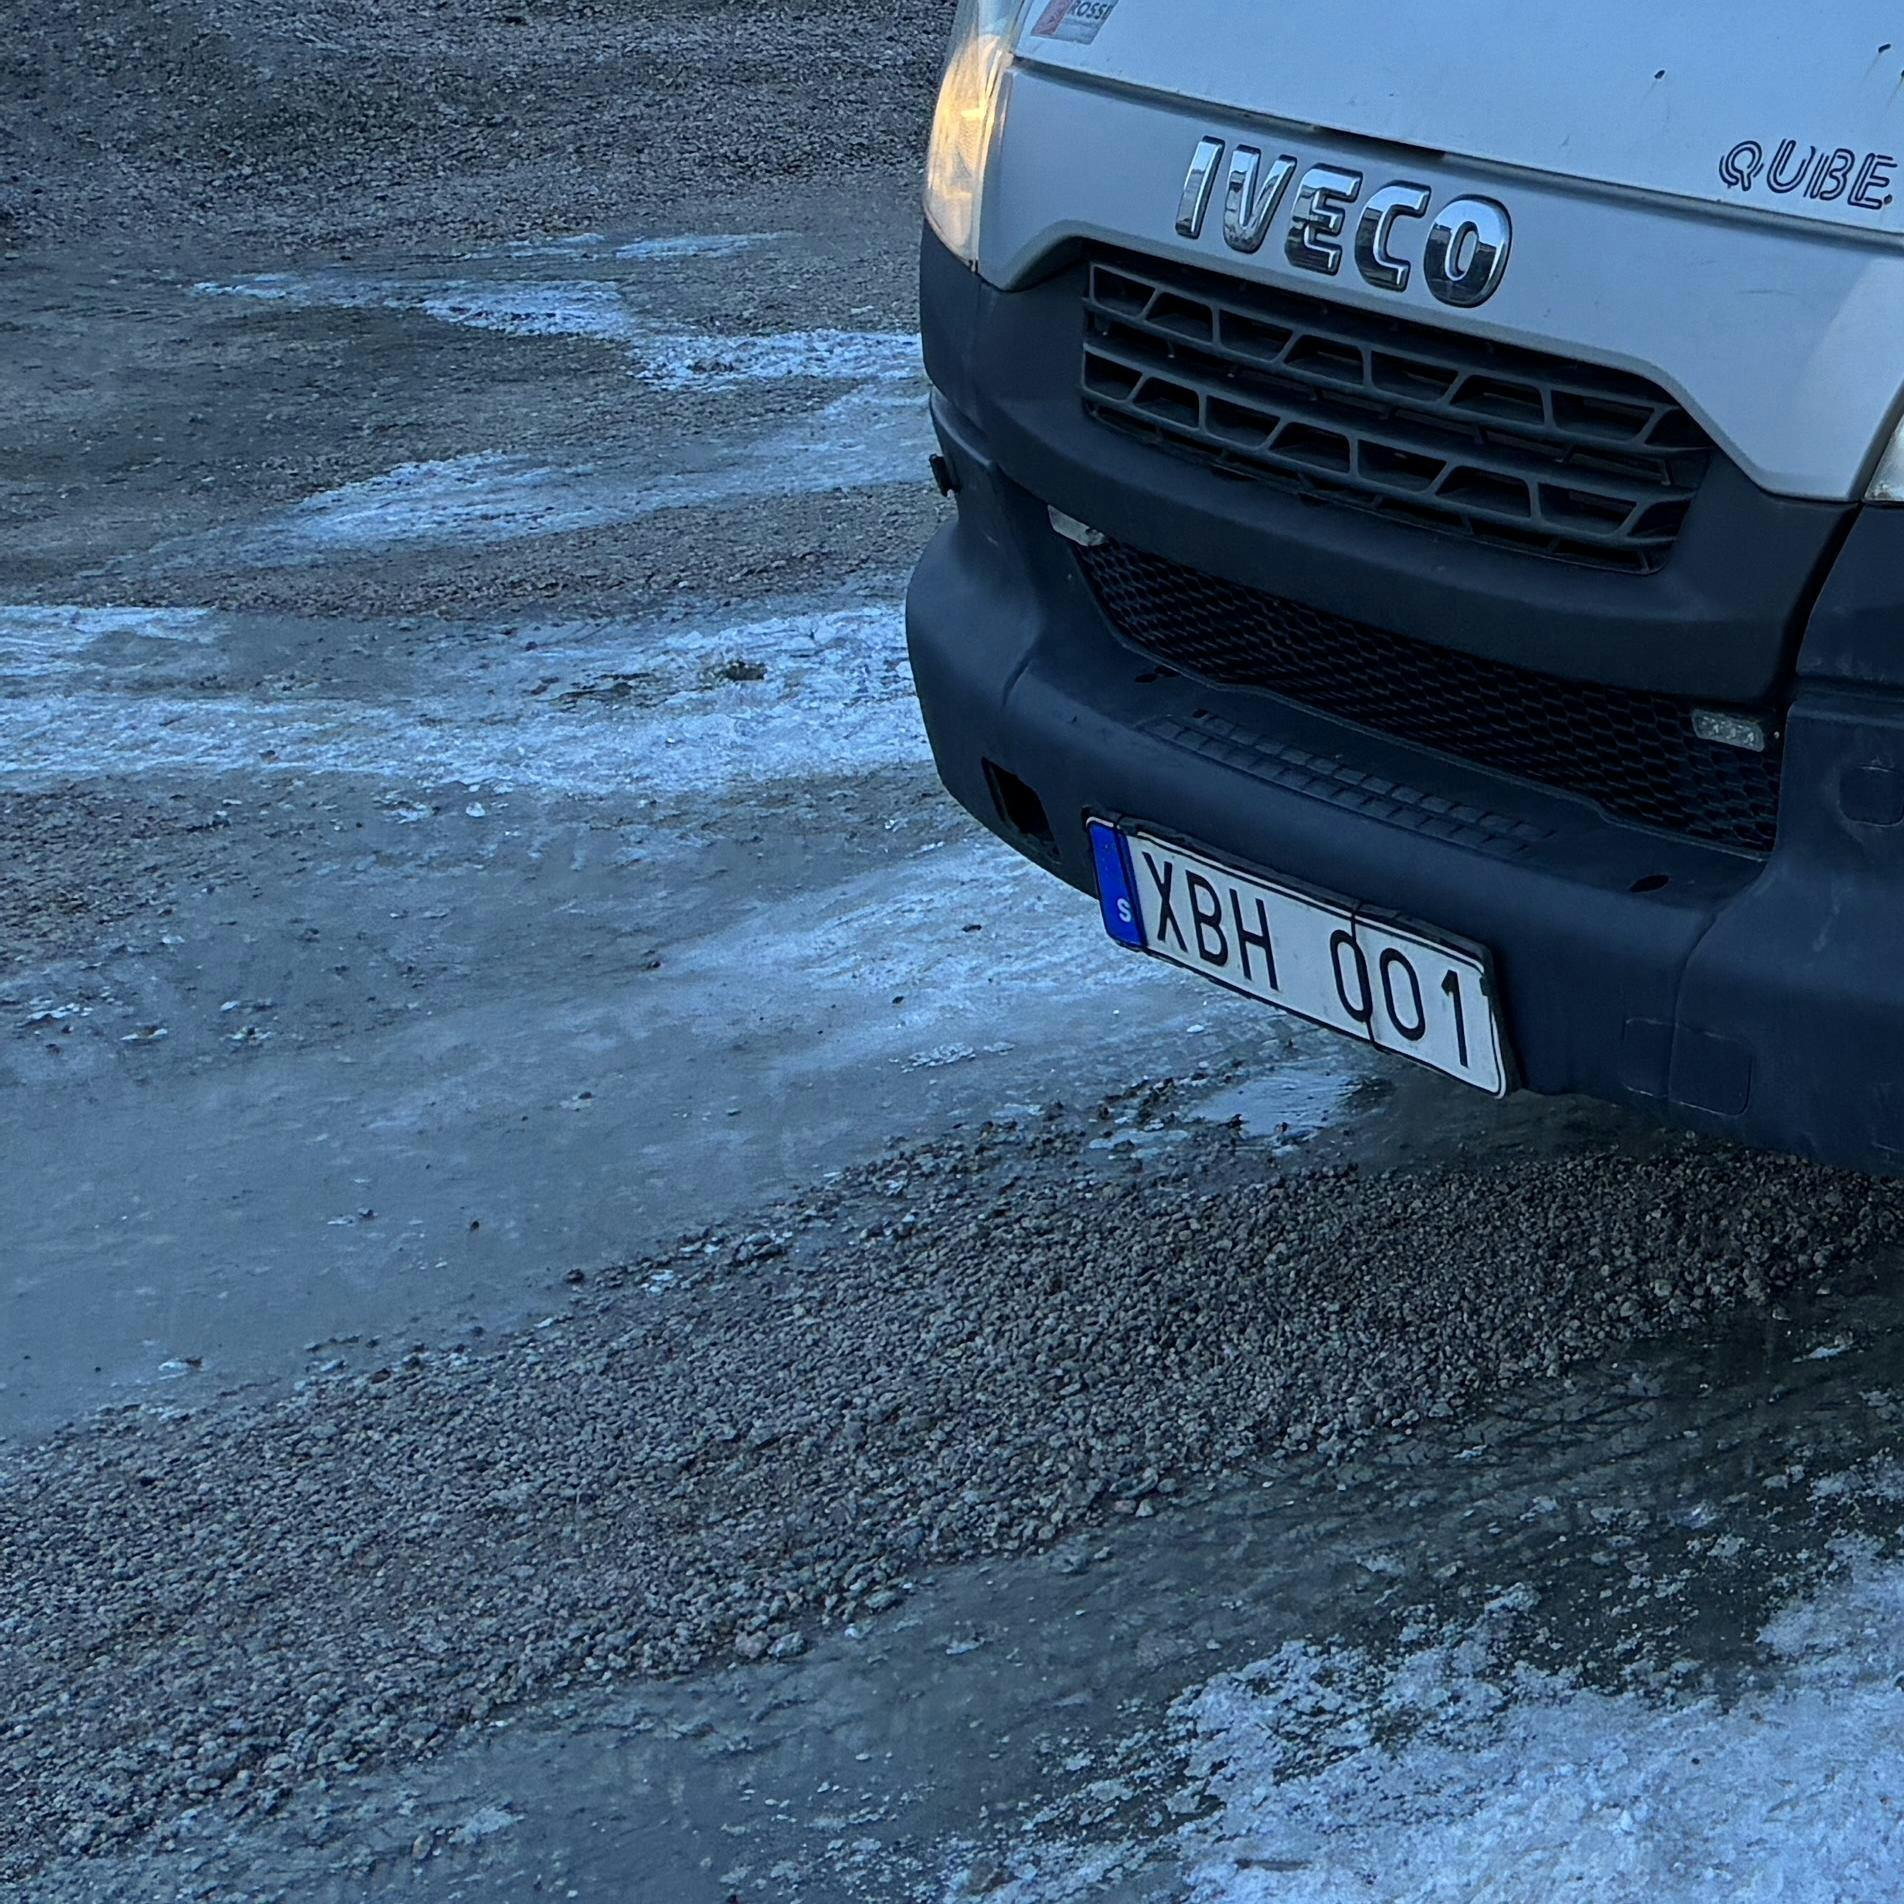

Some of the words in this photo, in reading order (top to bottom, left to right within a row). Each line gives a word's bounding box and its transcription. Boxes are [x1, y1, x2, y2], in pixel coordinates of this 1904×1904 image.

[1175, 135, 1513, 309] IVECO
[1718, 138, 1898, 210] QUBE
[1118, 897, 1132, 924] S
[1142, 851, 1280, 993] XBH
[1329, 928, 1469, 1069] 001
